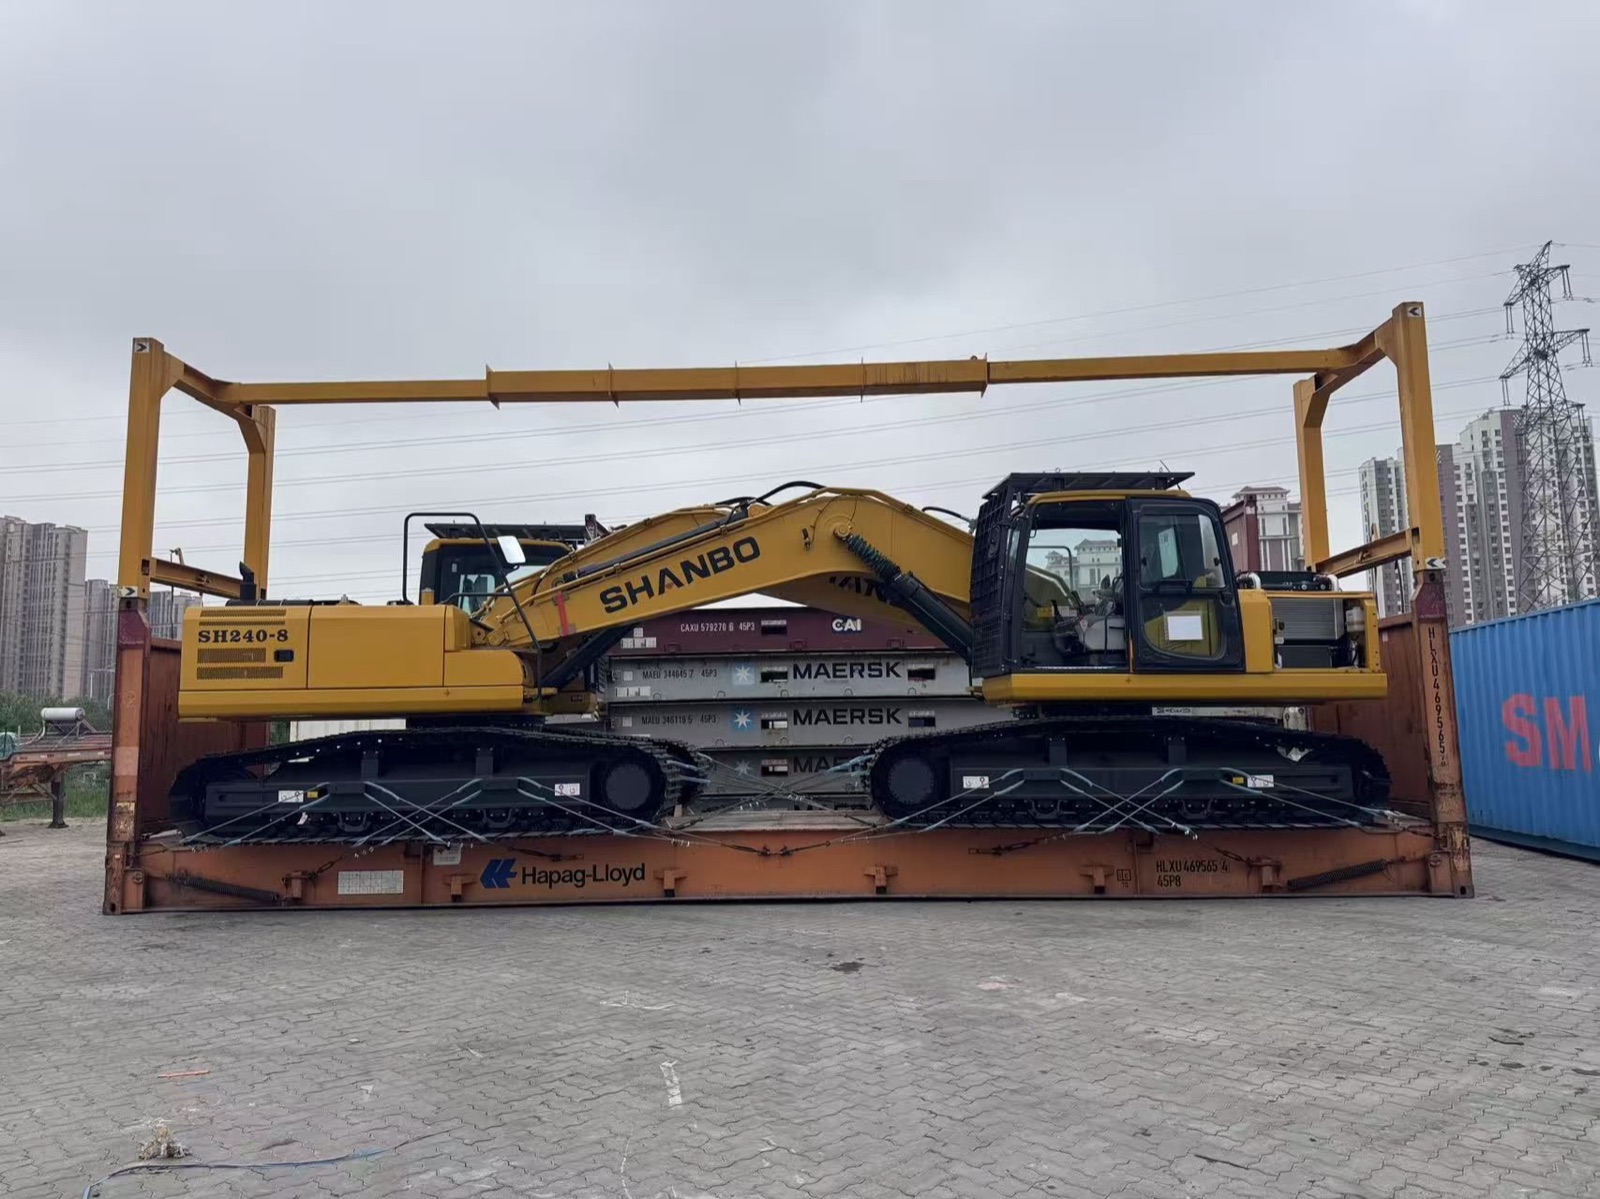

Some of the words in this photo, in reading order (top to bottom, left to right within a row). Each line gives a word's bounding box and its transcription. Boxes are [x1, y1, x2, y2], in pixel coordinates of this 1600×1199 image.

[600, 536, 761, 614] SHANBO
[680, 623, 699, 632] CAXU
[701, 622, 727, 632] 579270
[739, 621, 755, 631] 45P3
[832, 618, 862, 632] CAI
[198, 629, 288, 643] SH240-8
[642, 670, 660, 680] MAEU
[701, 668, 717, 678] 45P3
[793, 661, 902, 679] MAERSK
[700, 714, 717, 724] 45P3
[793, 707, 902, 726] MAERSK
[1502, 693, 1593, 773] SM
[1156, 860, 1182, 873] HLXU
[1183, 860, 1218, 873] 469565
[1221, 860, 1228, 872] 4
[521, 863, 645, 889] Hapag-Lloyd
[1157, 874, 1181, 888] 45P8
